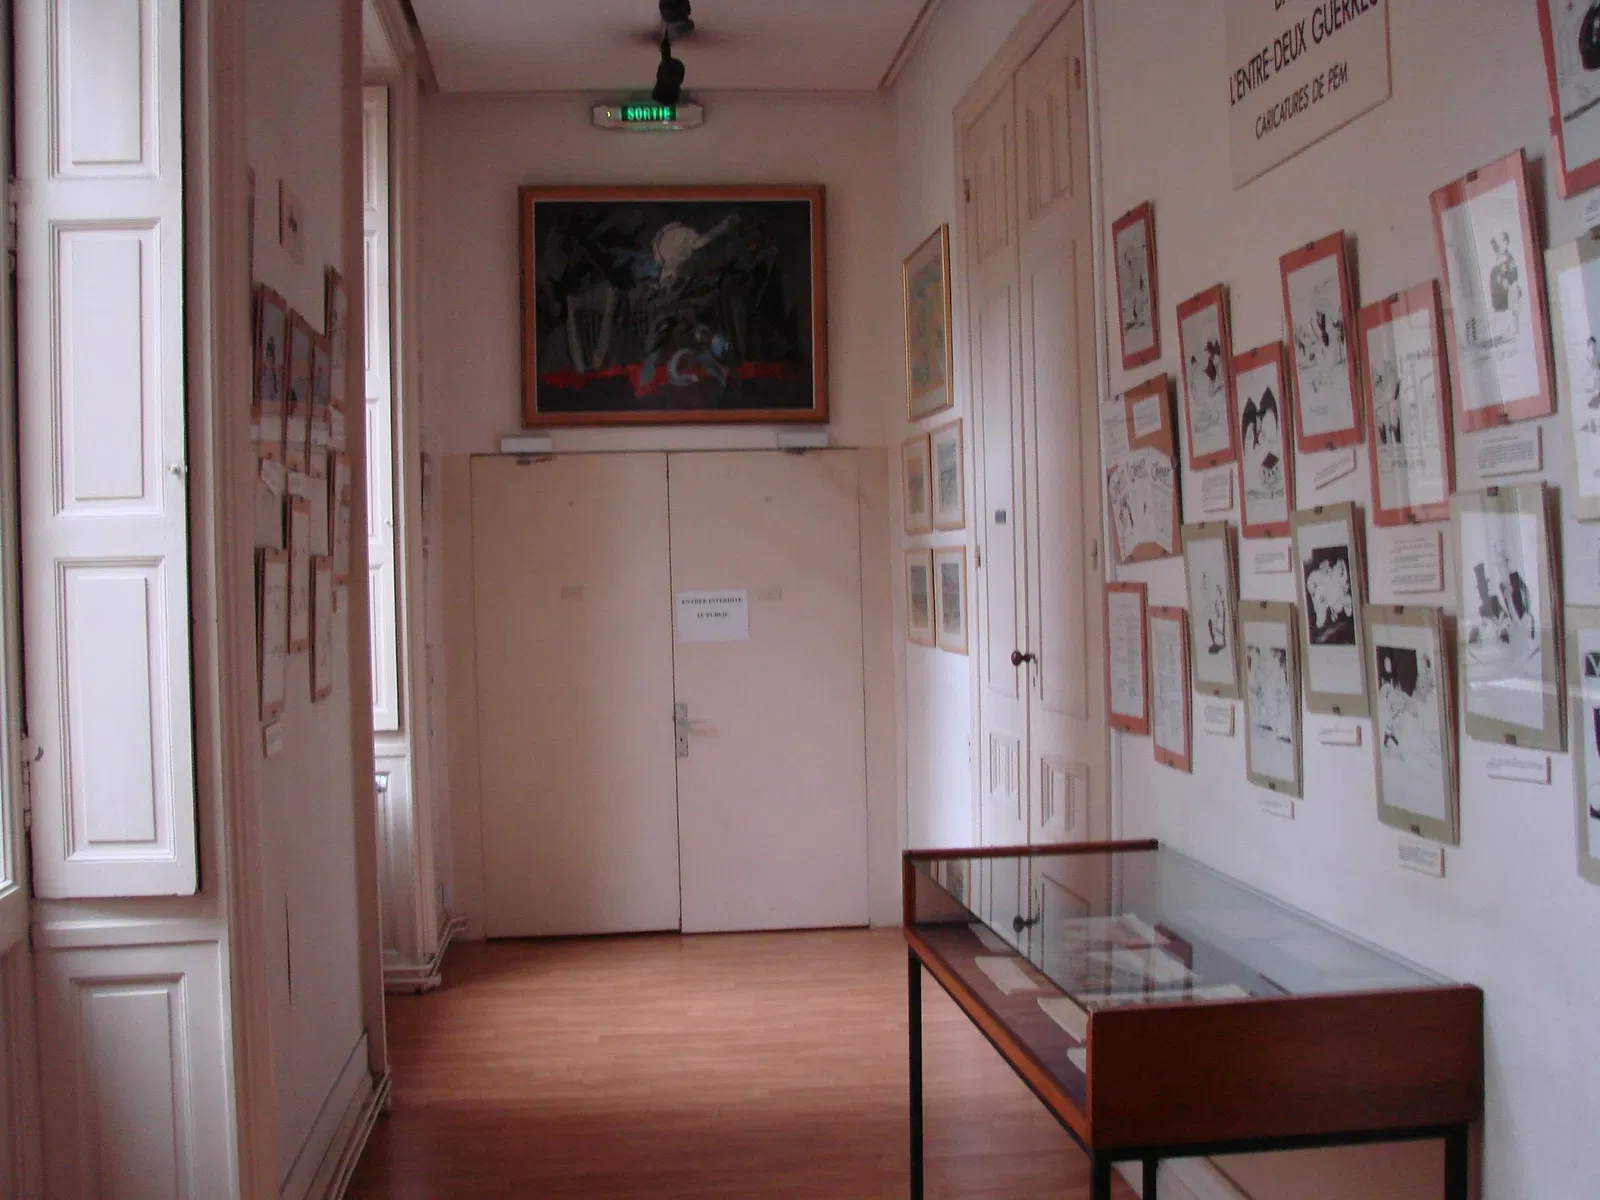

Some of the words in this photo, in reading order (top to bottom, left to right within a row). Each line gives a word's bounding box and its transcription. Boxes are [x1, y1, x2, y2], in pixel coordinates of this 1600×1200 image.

[1311, 0, 1379, 44] GUERR
[627, 107, 671, 121] SORTIE
[1255, 83, 1309, 140] CARICATURES
[1327, 61, 1348, 94] PEM
